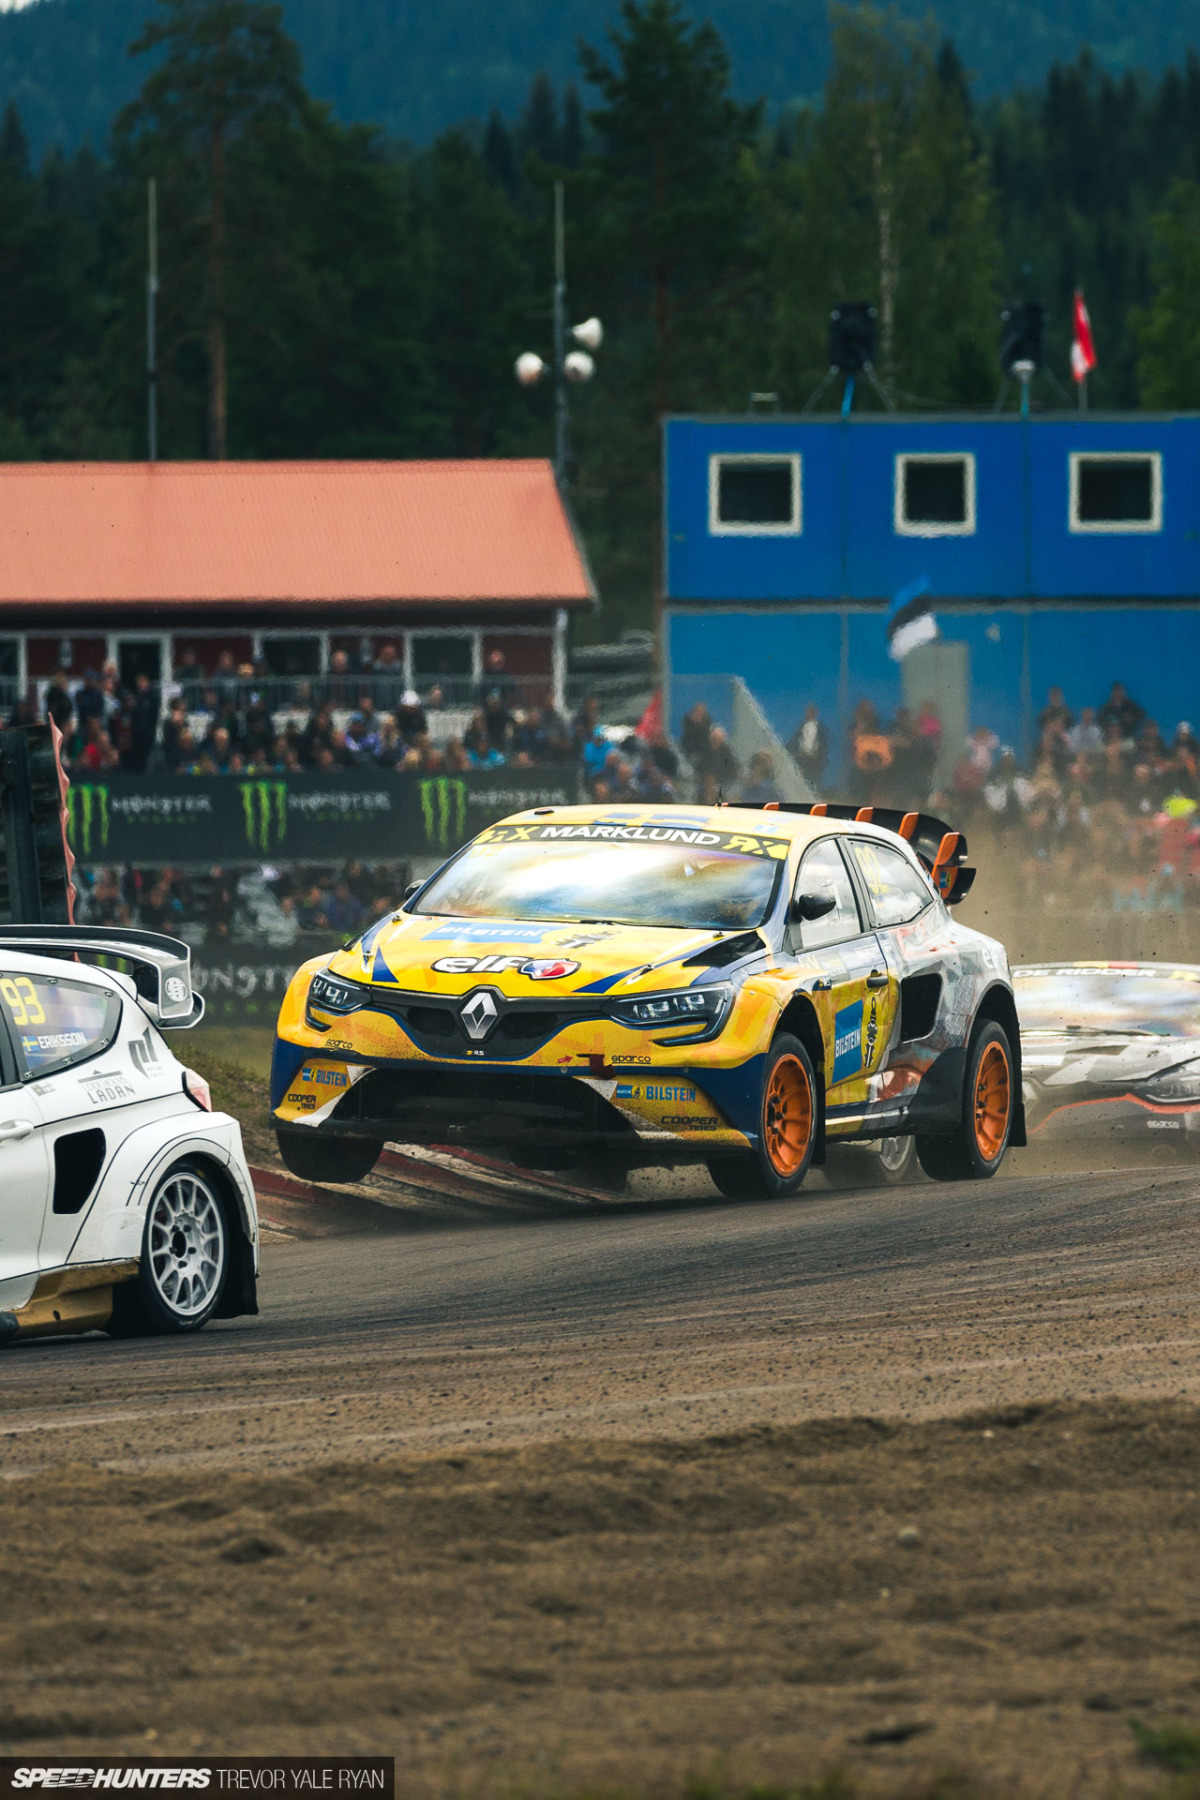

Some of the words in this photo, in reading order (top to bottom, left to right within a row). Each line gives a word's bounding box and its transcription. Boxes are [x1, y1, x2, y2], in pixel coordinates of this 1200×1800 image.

[540, 826, 721, 845] MARKLUND
[436, 927, 542, 937] BILSTEIN
[432, 955, 533, 973] elf
[1013, 969, 1049, 978] DE
[1056, 968, 1156, 977] RIDDER
[0, 977, 46, 1026] 93
[37, 1032, 88, 1049] ERIKSSON
[835, 1027, 861, 1058] BILSTEIN
[611, 1055, 652, 1064] sparco
[316, 1069, 348, 1087] BILSTEIN
[87, 1085, 135, 1104] LADAN
[287, 1093, 317, 1103] COOPER
[646, 1086, 697, 1101] BILSTEIN
[660, 1116, 719, 1125] COOPER
